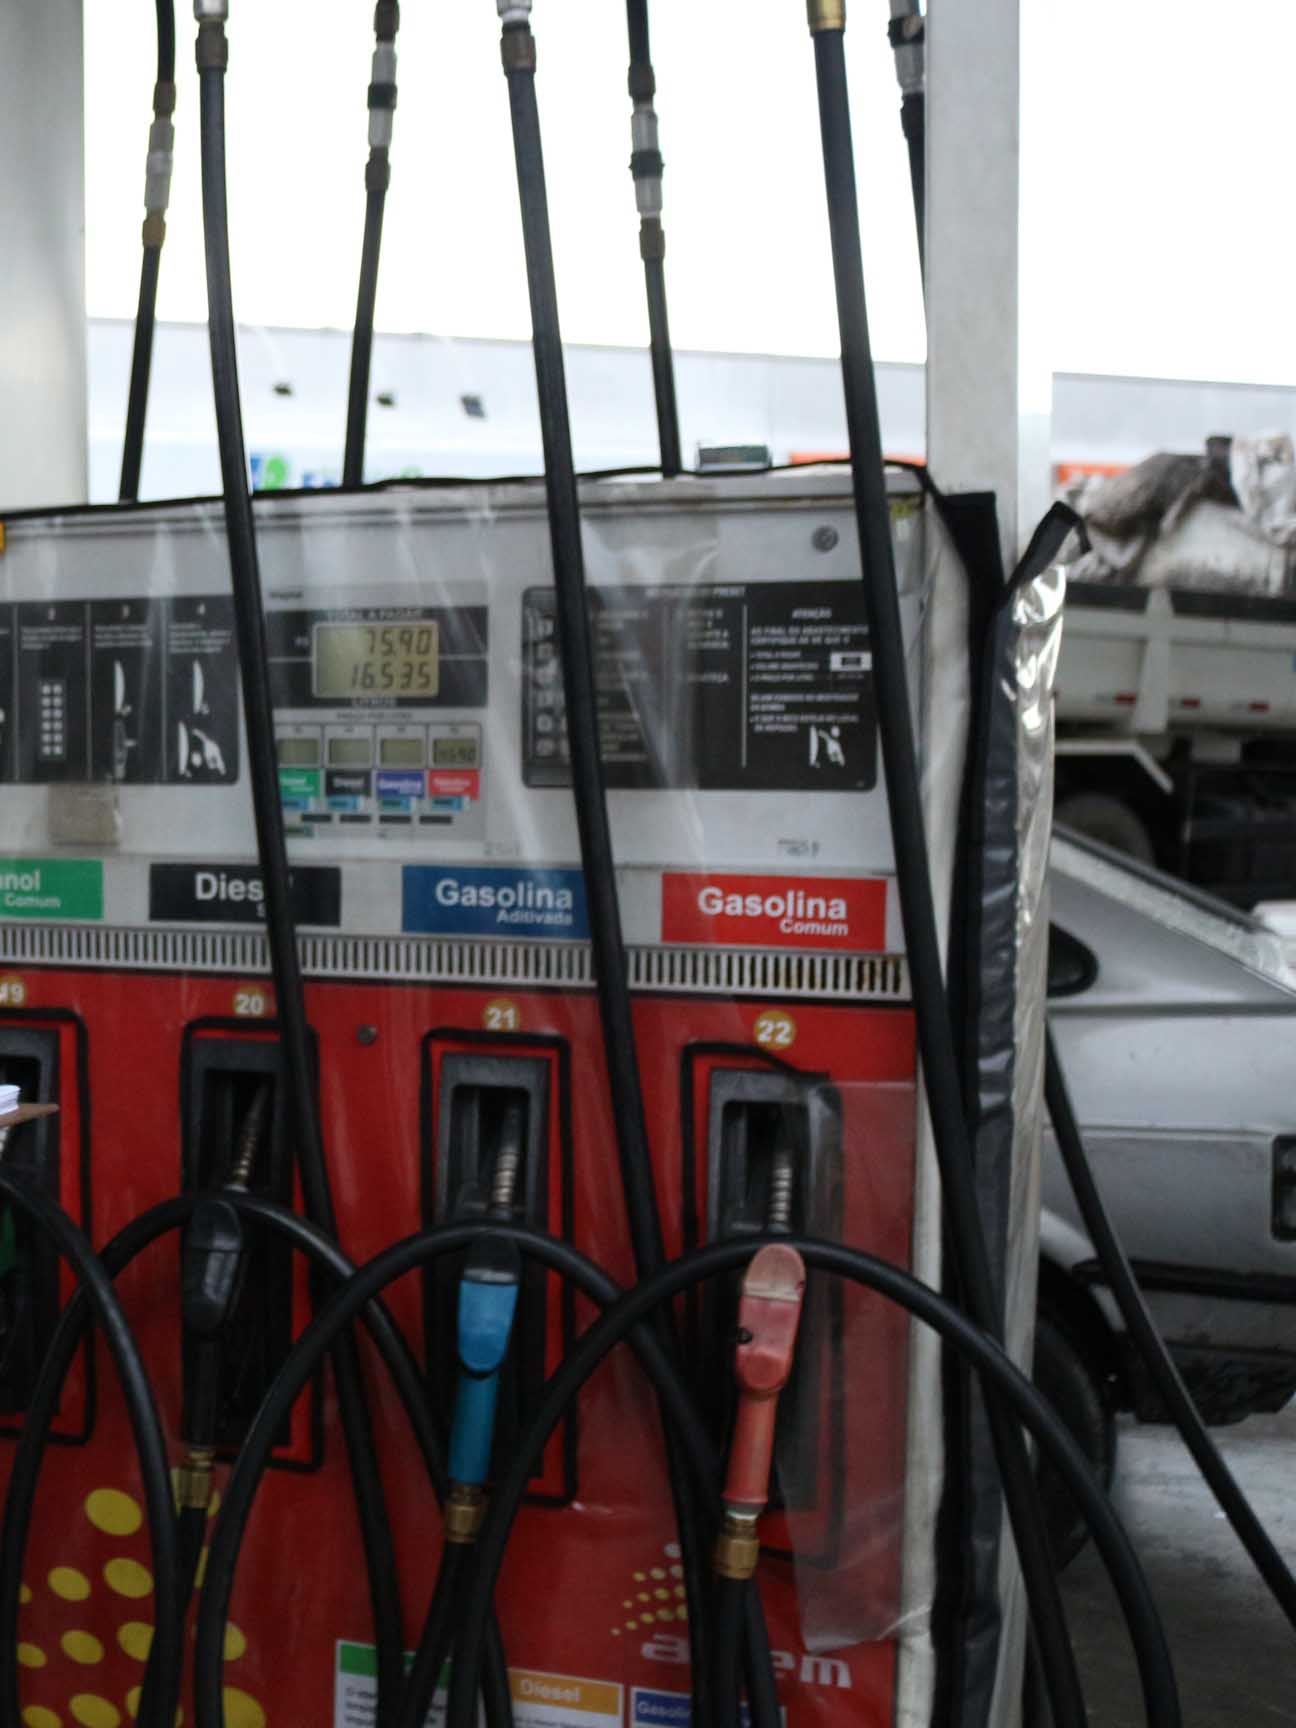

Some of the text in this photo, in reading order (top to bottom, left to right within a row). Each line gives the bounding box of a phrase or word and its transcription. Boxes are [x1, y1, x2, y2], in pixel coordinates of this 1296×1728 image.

[194, 873, 293, 902] Dies
[435, 878, 573, 911] Gasolina
[6, 893, 62, 910] Comum
[697, 886, 849, 921] Gasolina
[496, 908, 573, 926] Aditivada
[779, 918, 849, 937] Comum
[235, 994, 264, 1015] 20
[486, 1008, 517, 1028] 21
[757, 1020, 794, 1044] 22
[519, 1678, 582, 1704] Diesel
